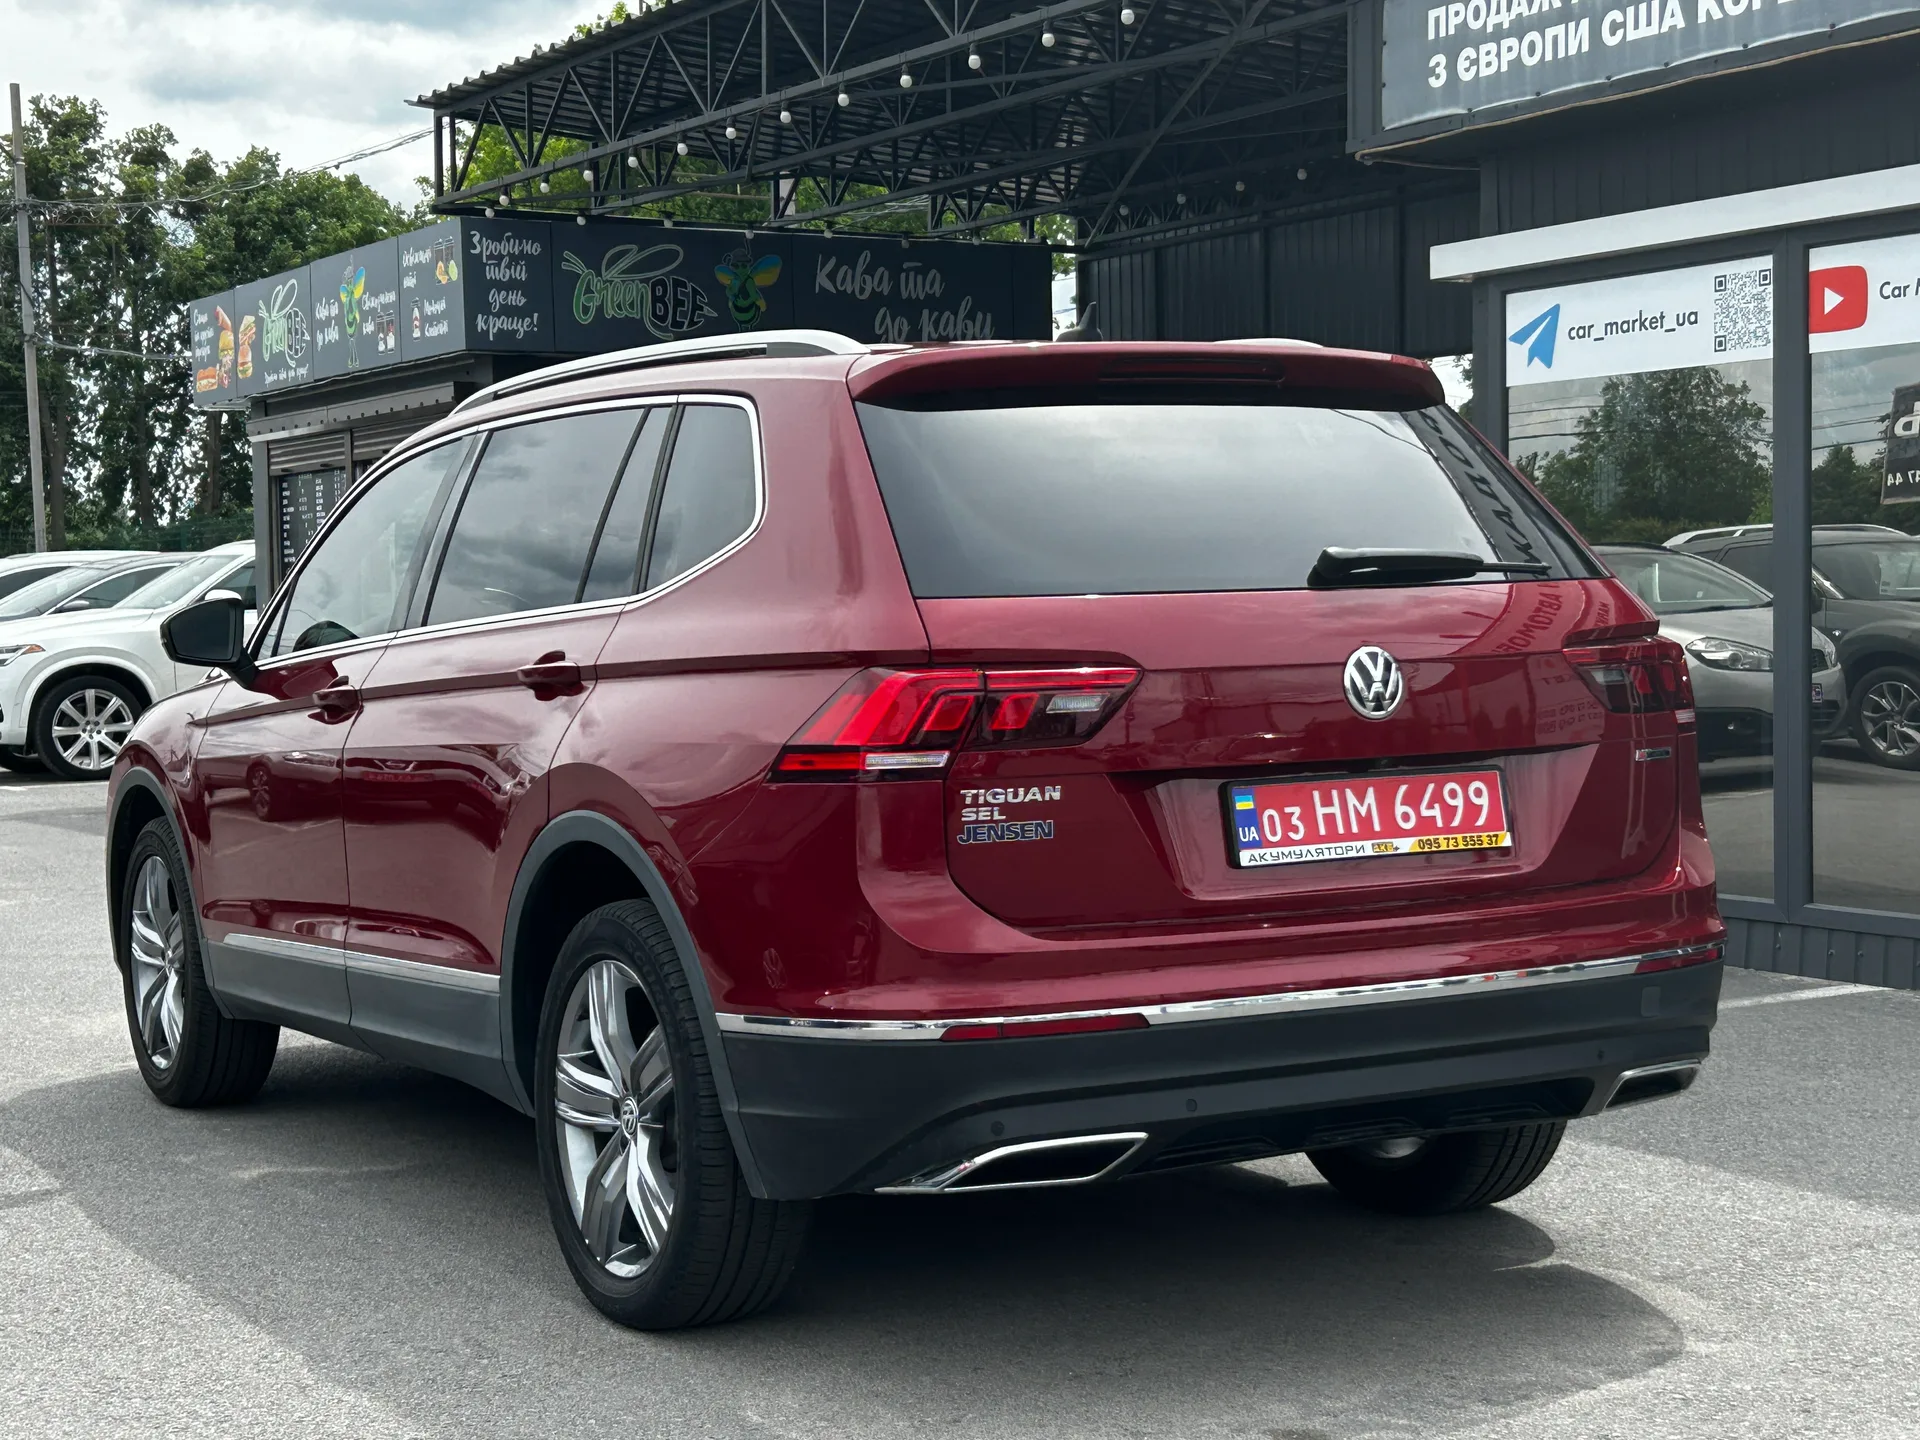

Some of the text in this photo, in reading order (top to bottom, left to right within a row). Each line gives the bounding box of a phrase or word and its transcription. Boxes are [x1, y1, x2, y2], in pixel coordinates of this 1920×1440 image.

[1456, 17, 1590, 82] ЄВРОПИ
[1601, 0, 1686, 47] США
[469, 231, 542, 263] Зробимо
[485, 256, 528, 282] твій
[815, 250, 945, 301] Кава та
[488, 287, 527, 312] день
[1879, 281, 1911, 300] Car
[475, 313, 539, 341] краще!
[874, 295, 995, 342] до кави
[1567, 310, 1699, 342] car_market_ua
[960, 785, 1062, 805] TIGUAN
[961, 806, 1007, 821] SEL
[1262, 780, 1489, 842] 03 HM 6499
[957, 820, 1054, 844] JENSEN
[1239, 826, 1260, 842] UA
[1417, 837, 1441, 850] 095
[1443, 836, 1460, 849] 73
[1486, 833, 1500, 846] 37
[1248, 845, 1366, 864] АКУМУЛЯТОРИ
